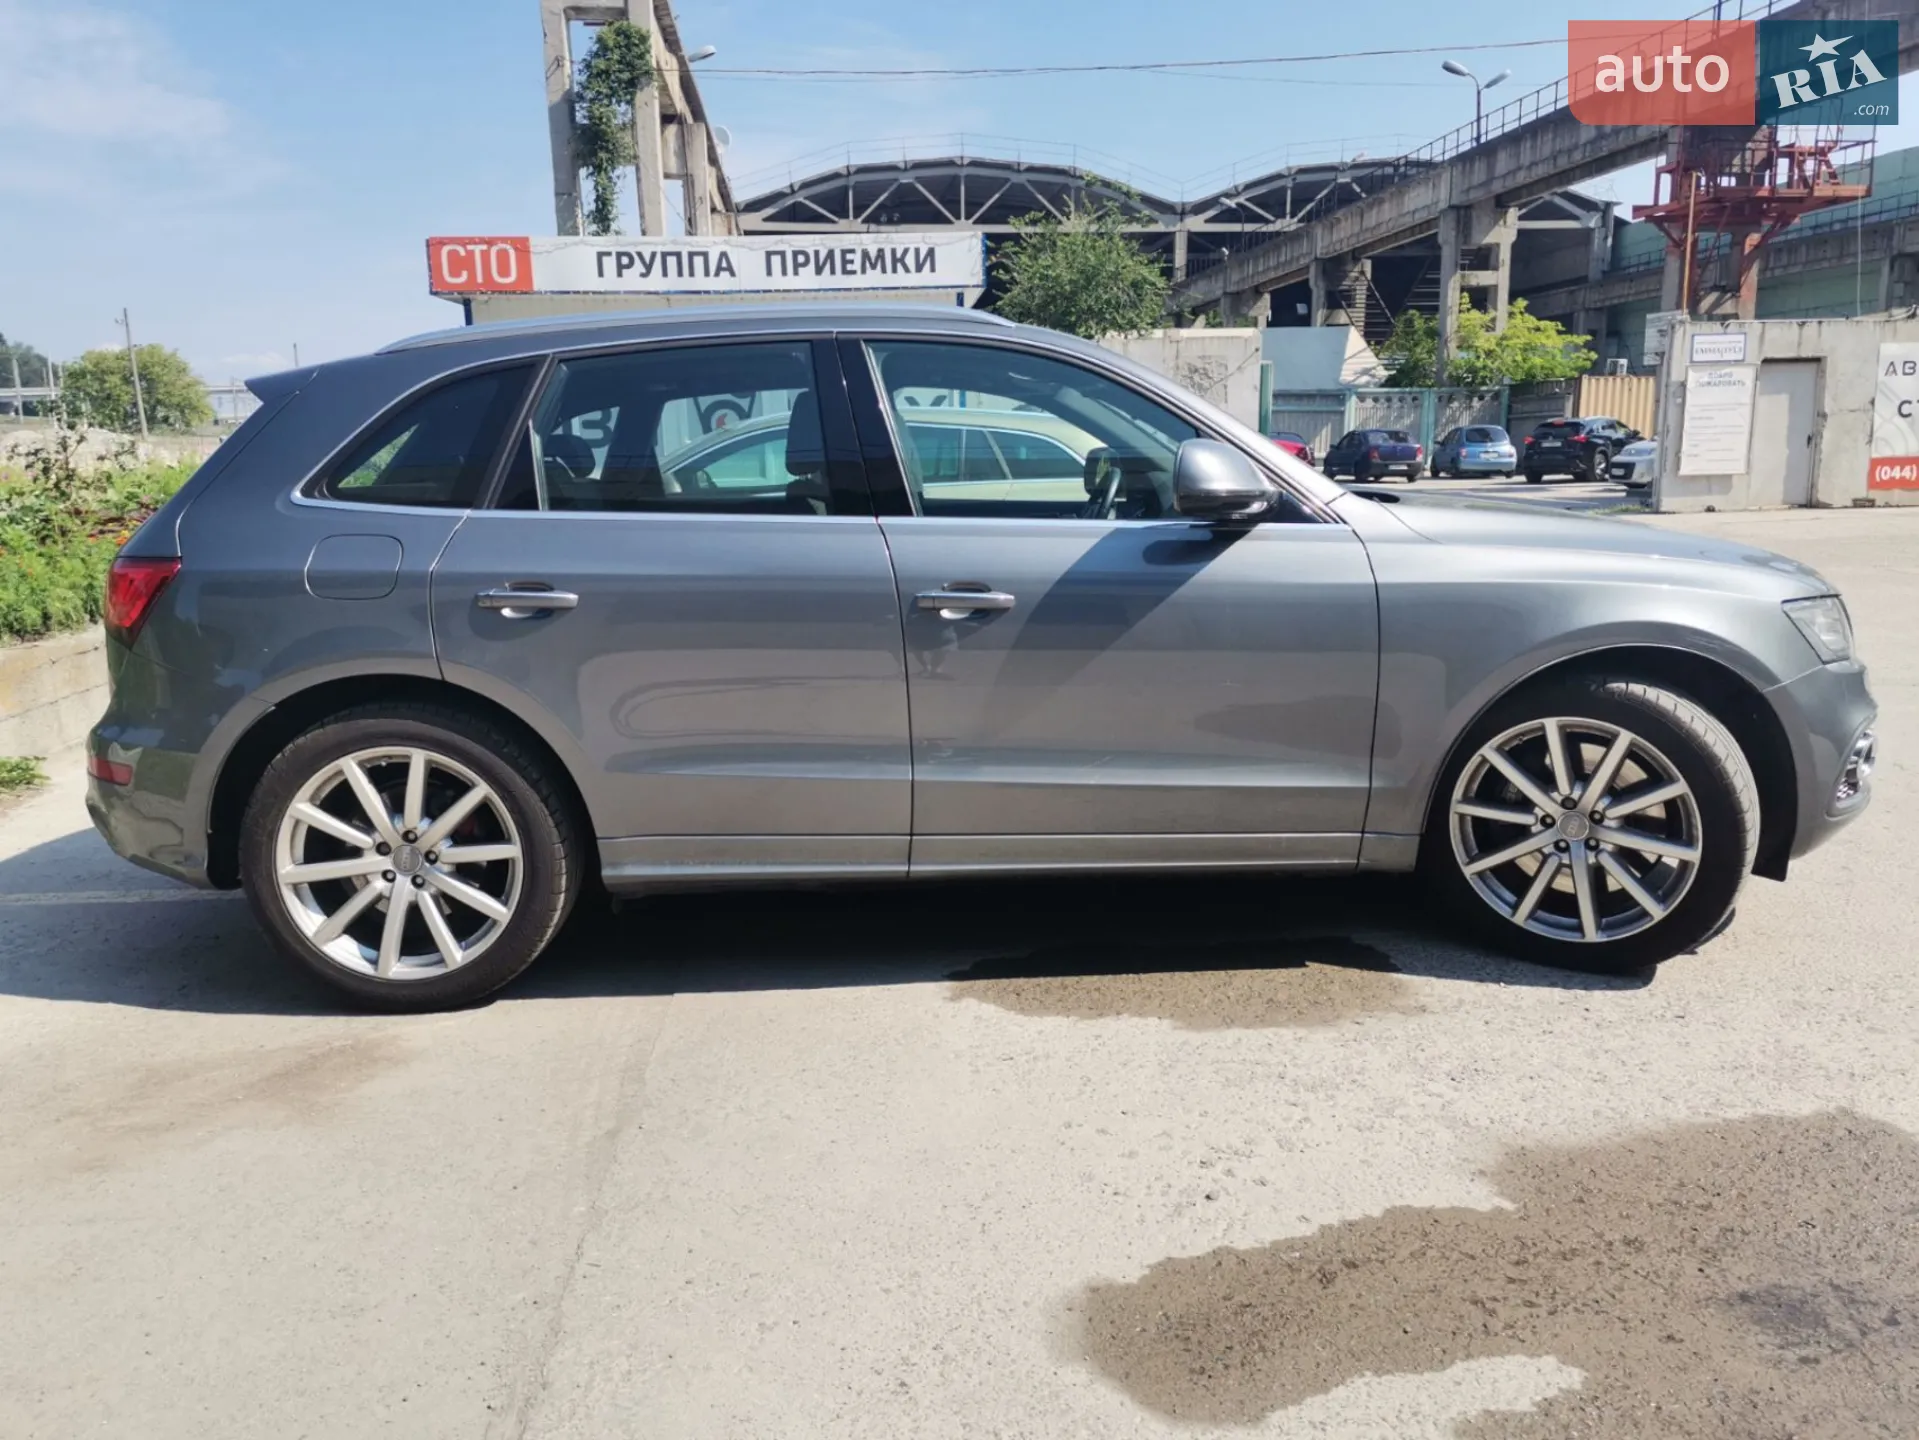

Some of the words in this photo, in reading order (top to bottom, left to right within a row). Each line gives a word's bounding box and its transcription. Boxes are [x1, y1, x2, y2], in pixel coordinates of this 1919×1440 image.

[441, 243, 517, 284] СТО
[596, 250, 737, 278] ГРУППА
[764, 246, 936, 277] ПРИЕМКИ
[1897, 399, 1919, 418] С
[1875, 464, 1917, 482] (044)
